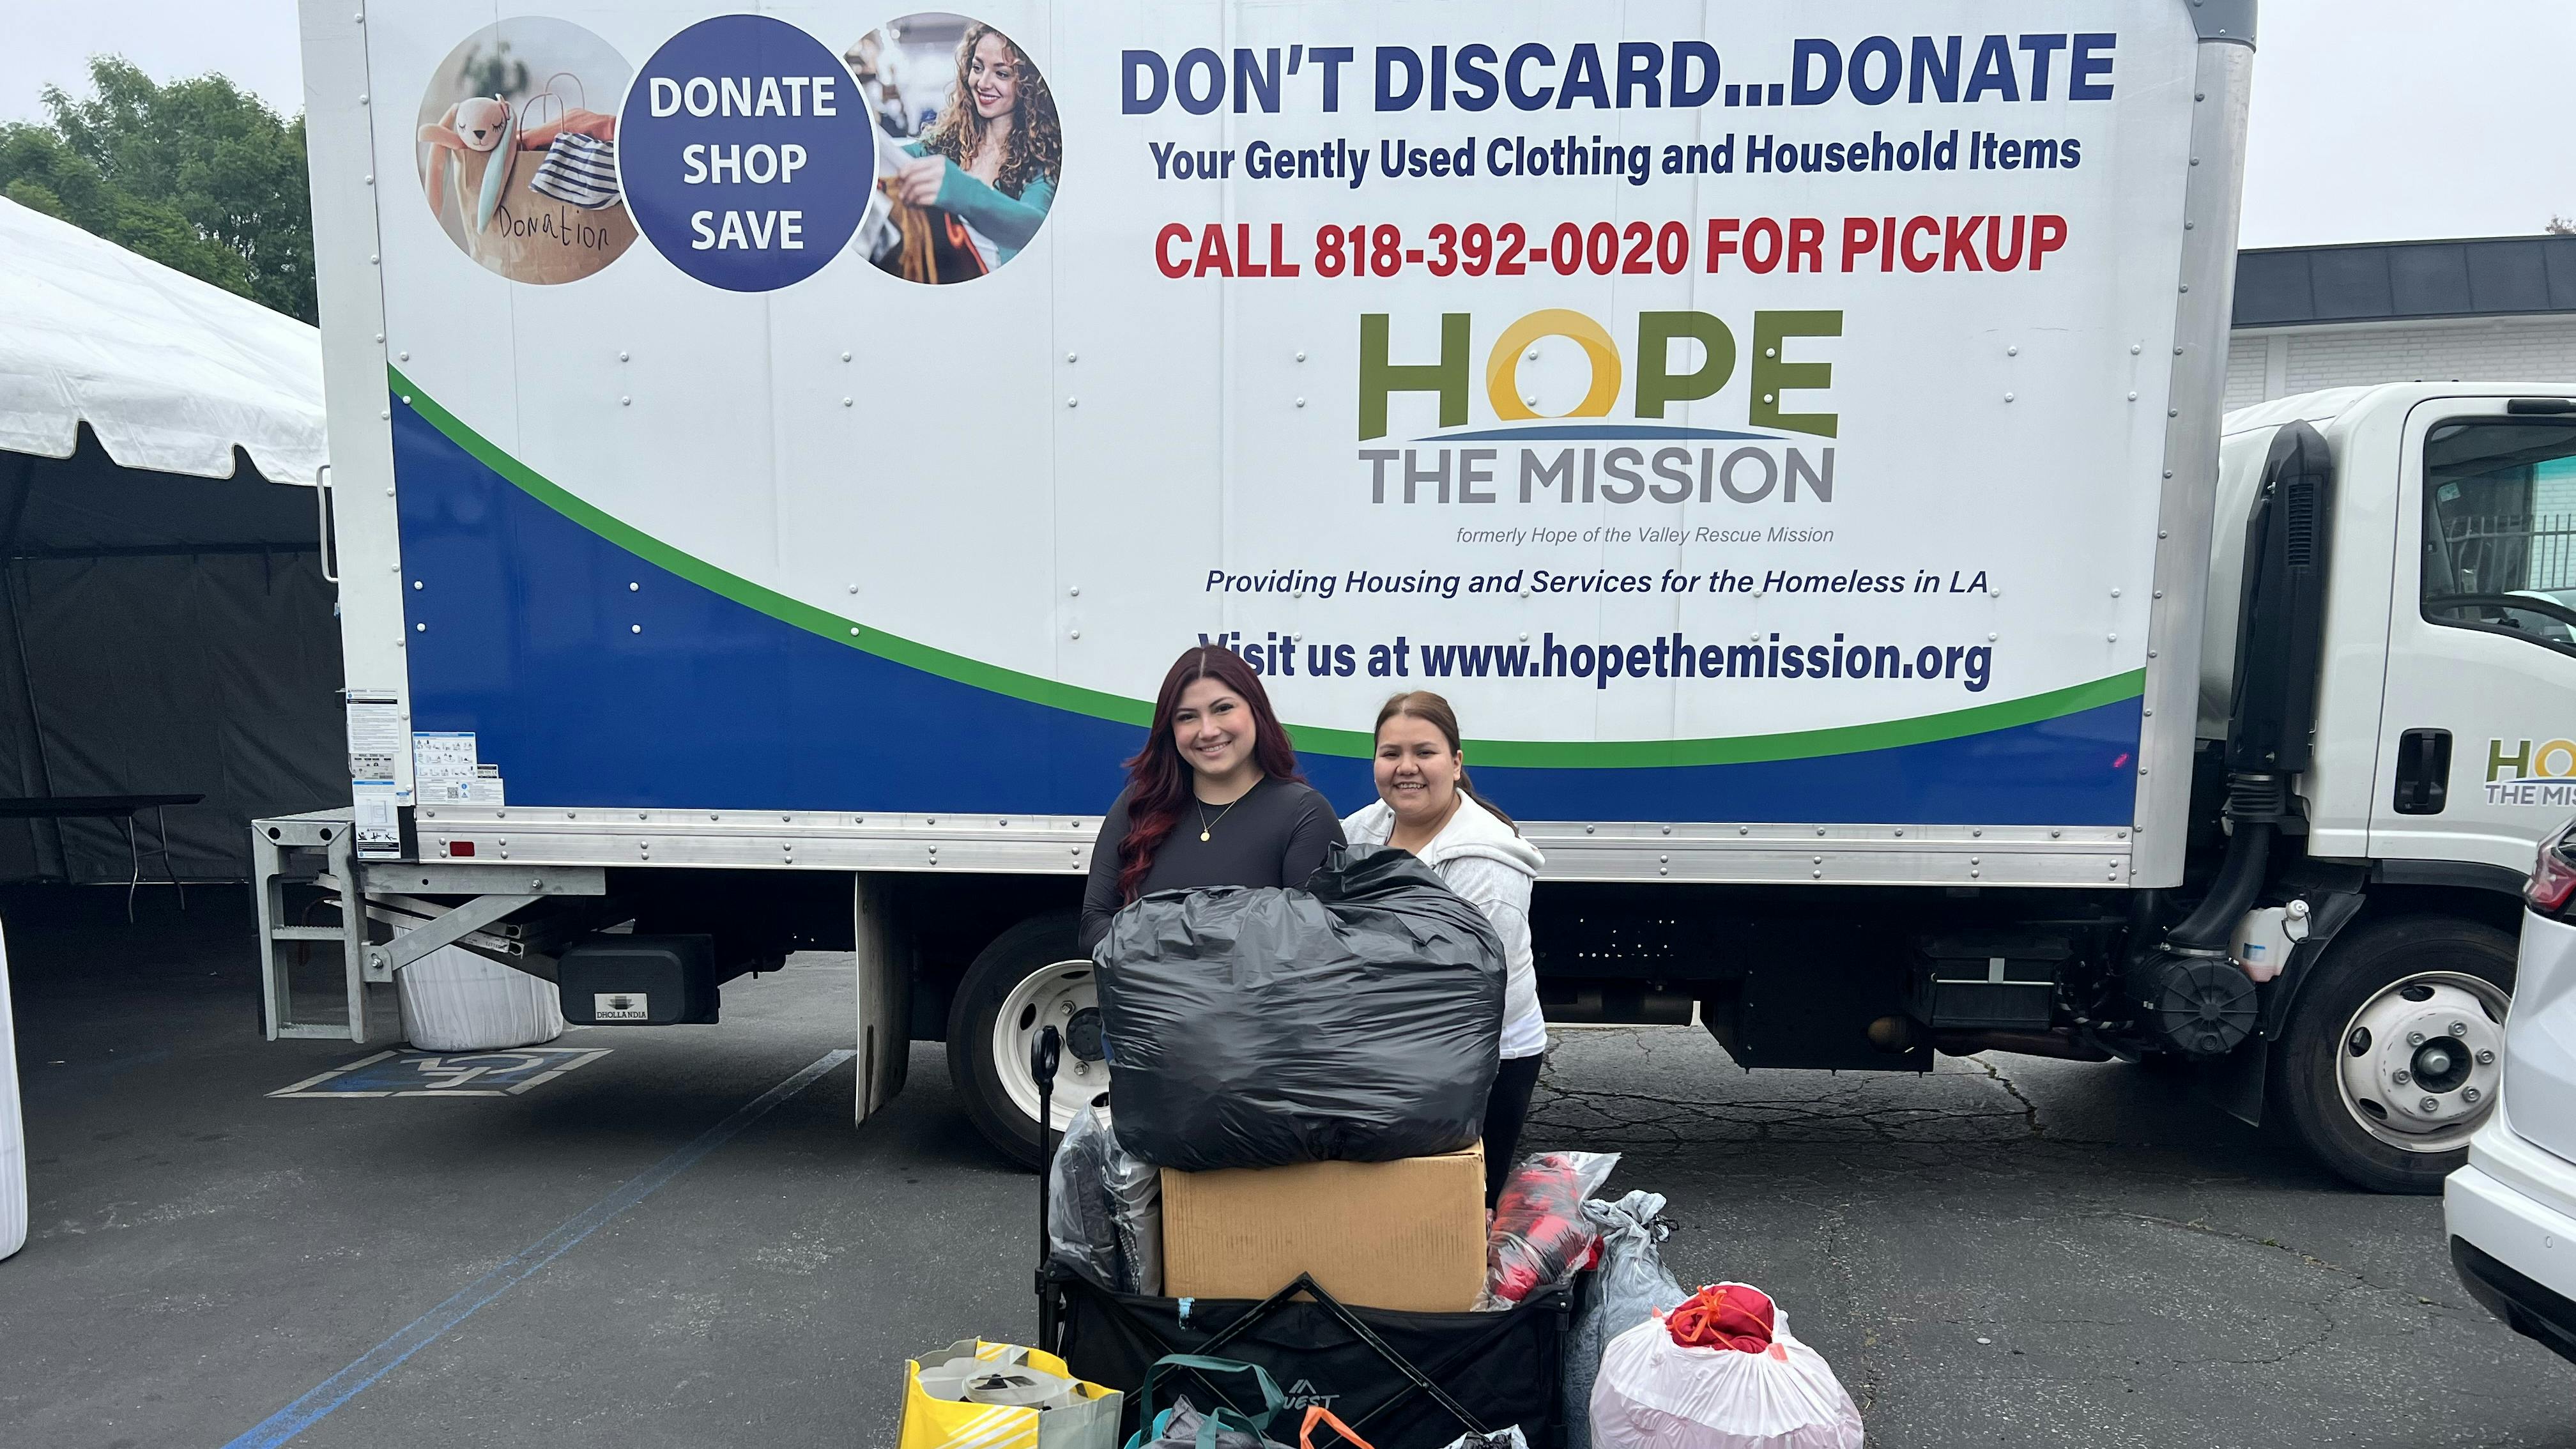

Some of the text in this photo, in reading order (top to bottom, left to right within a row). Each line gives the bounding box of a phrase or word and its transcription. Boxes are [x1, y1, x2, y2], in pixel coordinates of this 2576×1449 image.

[650, 77, 836, 117] DONATE
[1122, 45, 1353, 115] DON'T
[684, 144, 806, 183] SHOP
[1149, 130, 2080, 189] Your Gently Used Clothing and Household Items
[691, 211, 803, 249] SAVE
[1156, 215, 2067, 278] CALL 818-392-0020 FOR PICKUP
[1358, 308, 1843, 441] HOPE
[1359, 447, 1834, 503] THE MISSION
[1457, 527, 1834, 546] formerly Hope of the Valley Rescue Mission
[1206, 569, 1987, 599] Providing Housing and Services for the Homeless in LA
[1308, 645, 1355, 677] us
[1368, 636, 1409, 677] at
[1422, 632, 1992, 693] www.hopethemission.org
[2485, 785, 2536, 804] THE
[1282, 1395, 1340, 1410] UEST
